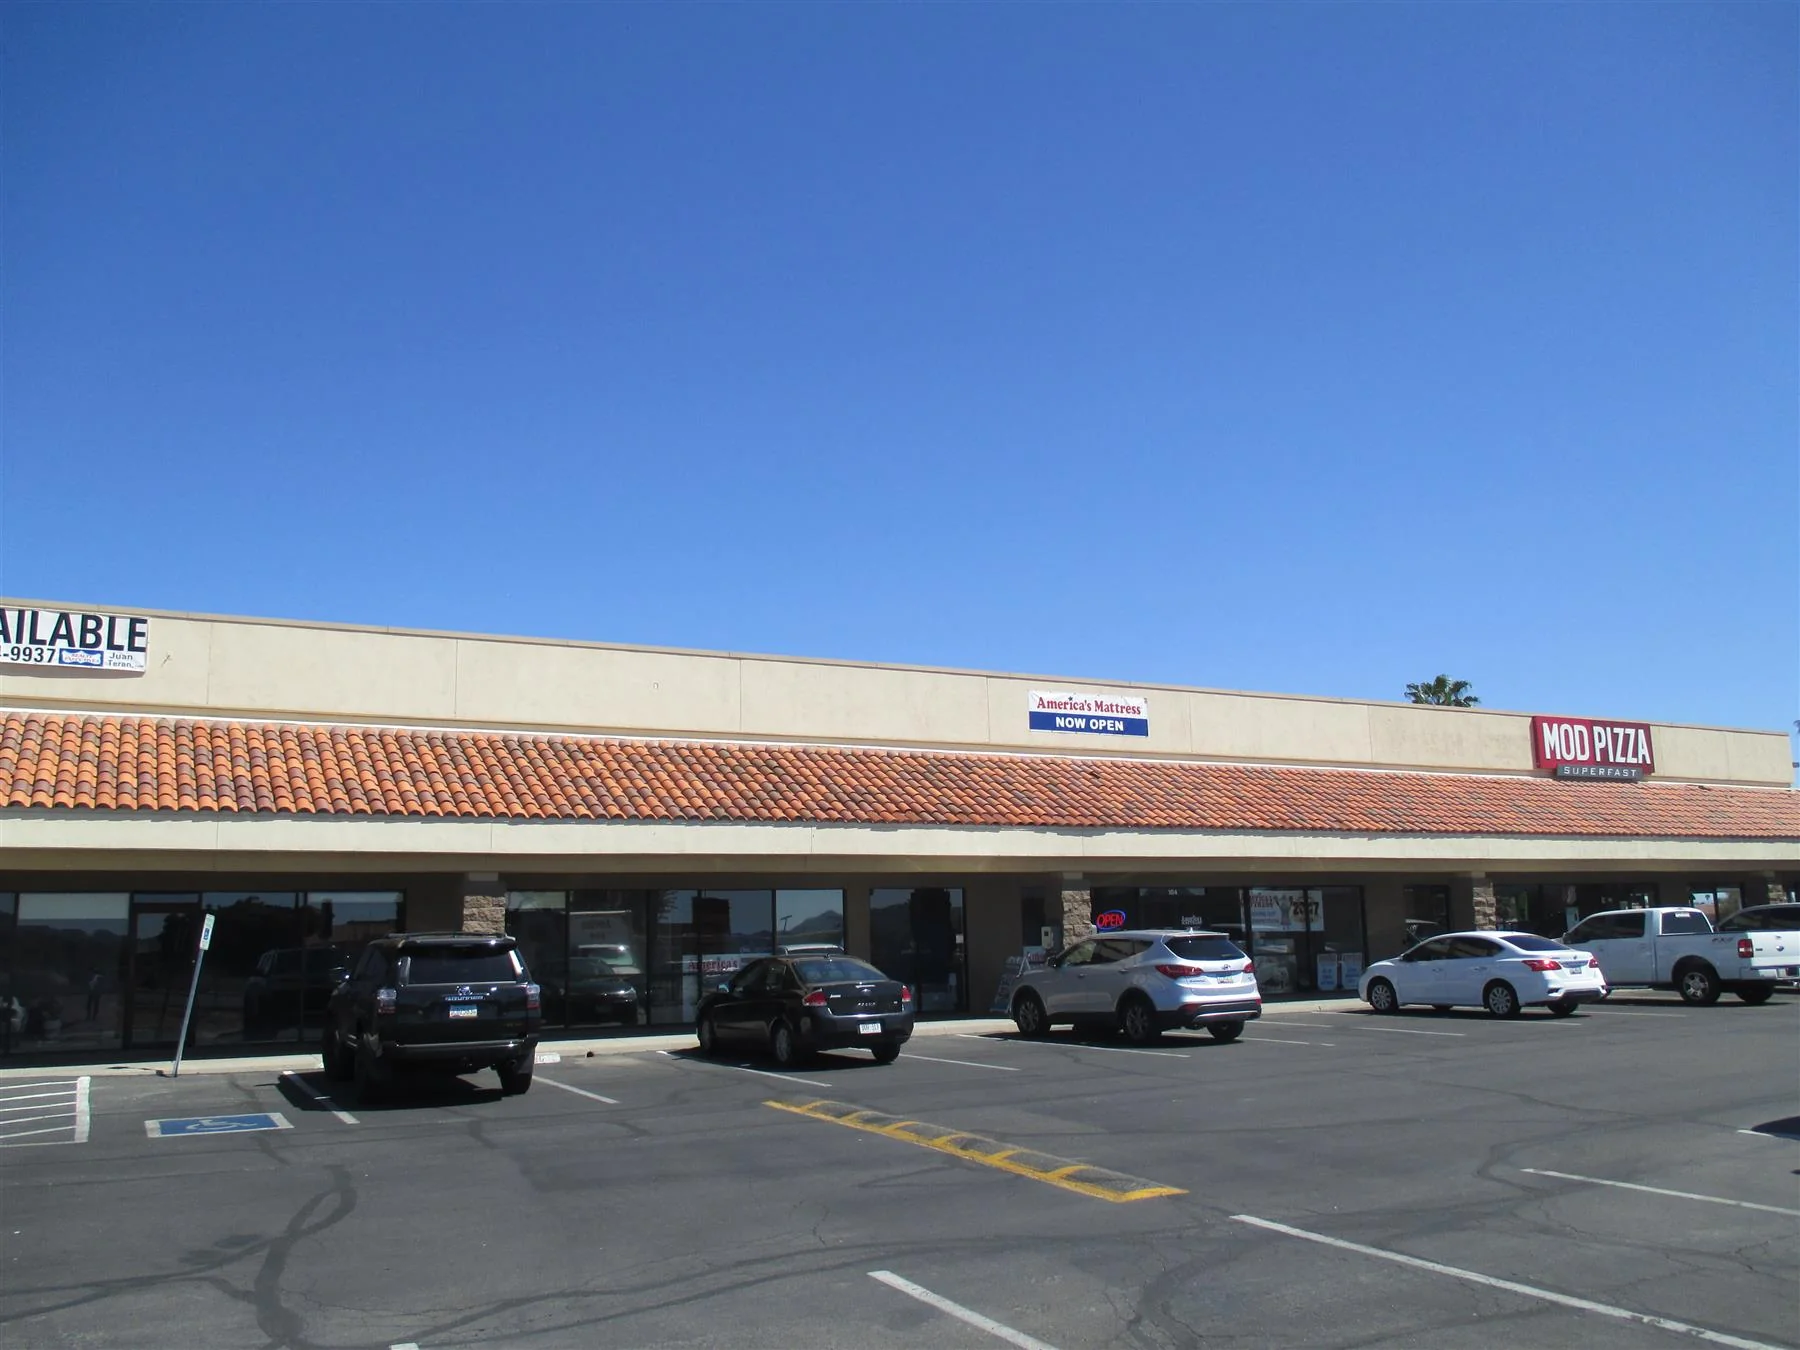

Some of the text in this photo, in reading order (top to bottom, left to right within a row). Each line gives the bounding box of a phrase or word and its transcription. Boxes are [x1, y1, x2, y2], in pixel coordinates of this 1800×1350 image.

[0, 646, 56, 663] -9937
[109, 652, 133, 660] Juan
[1037, 696, 1141, 715] America's Mattress
[1055, 716, 1124, 731] NOW OPEN
[1542, 722, 1651, 764] MOD PIZZA
[1563, 766, 1637, 777] SUPERFAST
[1096, 913, 1123, 927] OPEN
